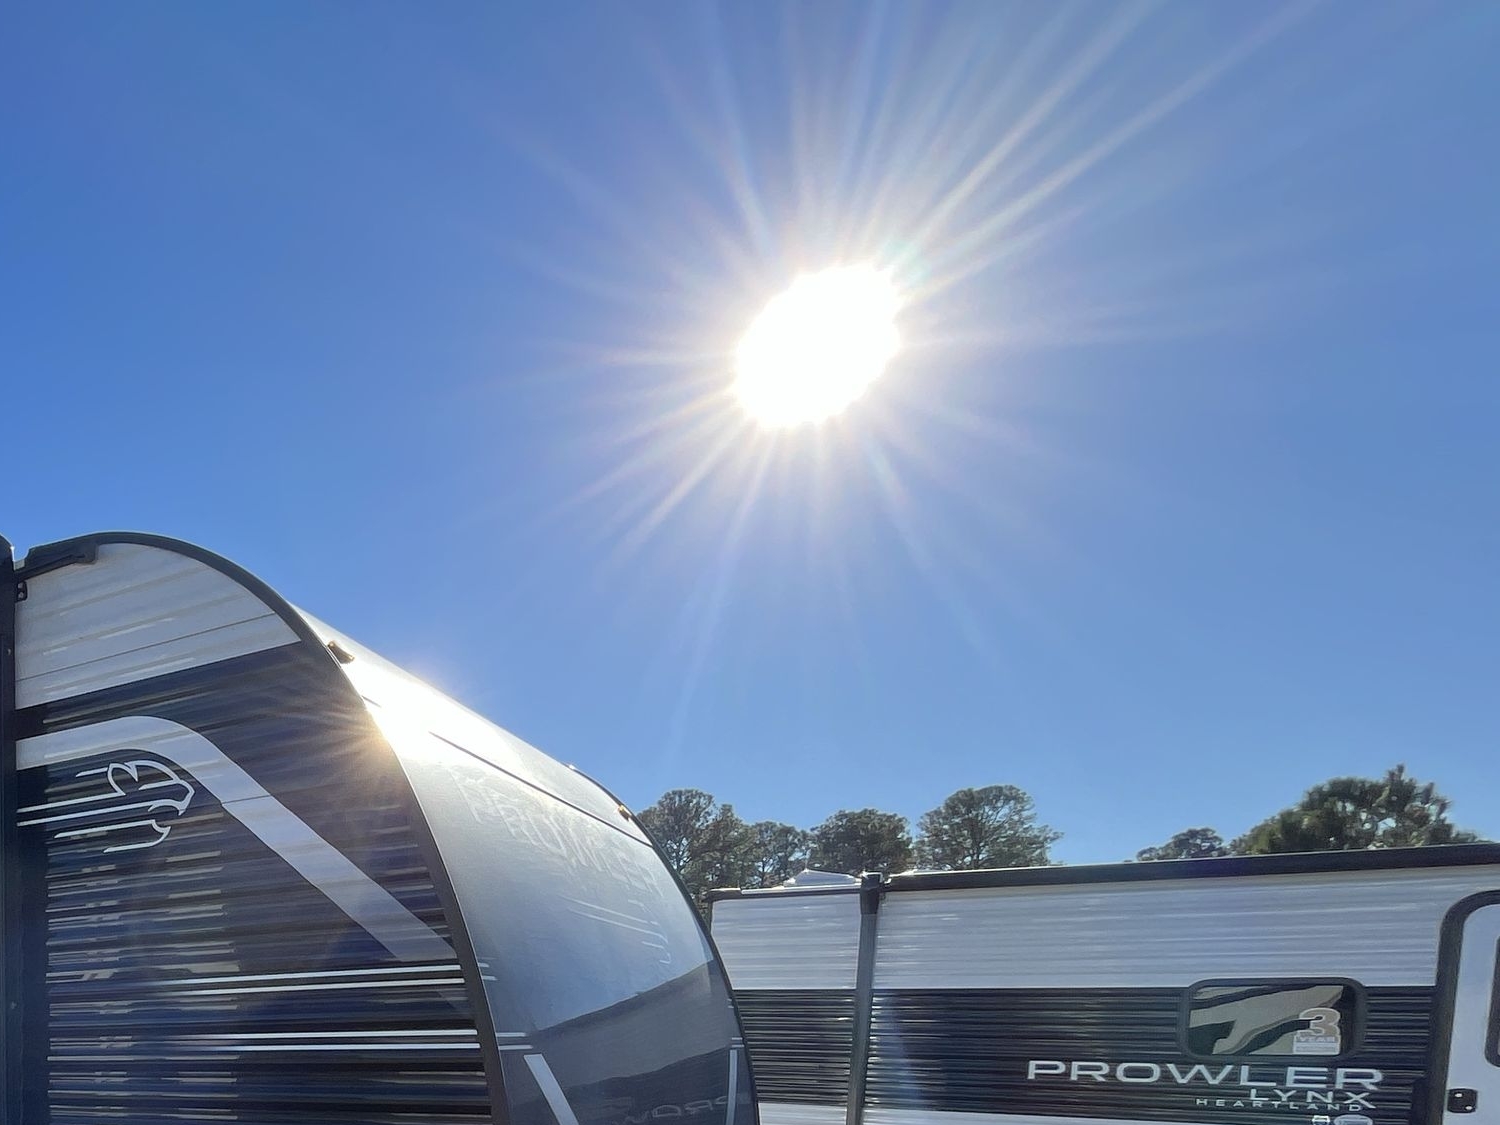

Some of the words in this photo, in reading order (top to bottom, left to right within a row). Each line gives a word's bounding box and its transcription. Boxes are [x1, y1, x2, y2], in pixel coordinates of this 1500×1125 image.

[1297, 1007, 1341, 1036] 3
[1026, 1060, 1383, 1090] PROWLER
[1196, 1098, 1362, 1112] HEARTLAND
[1250, 1088, 1376, 1108] LYNX
